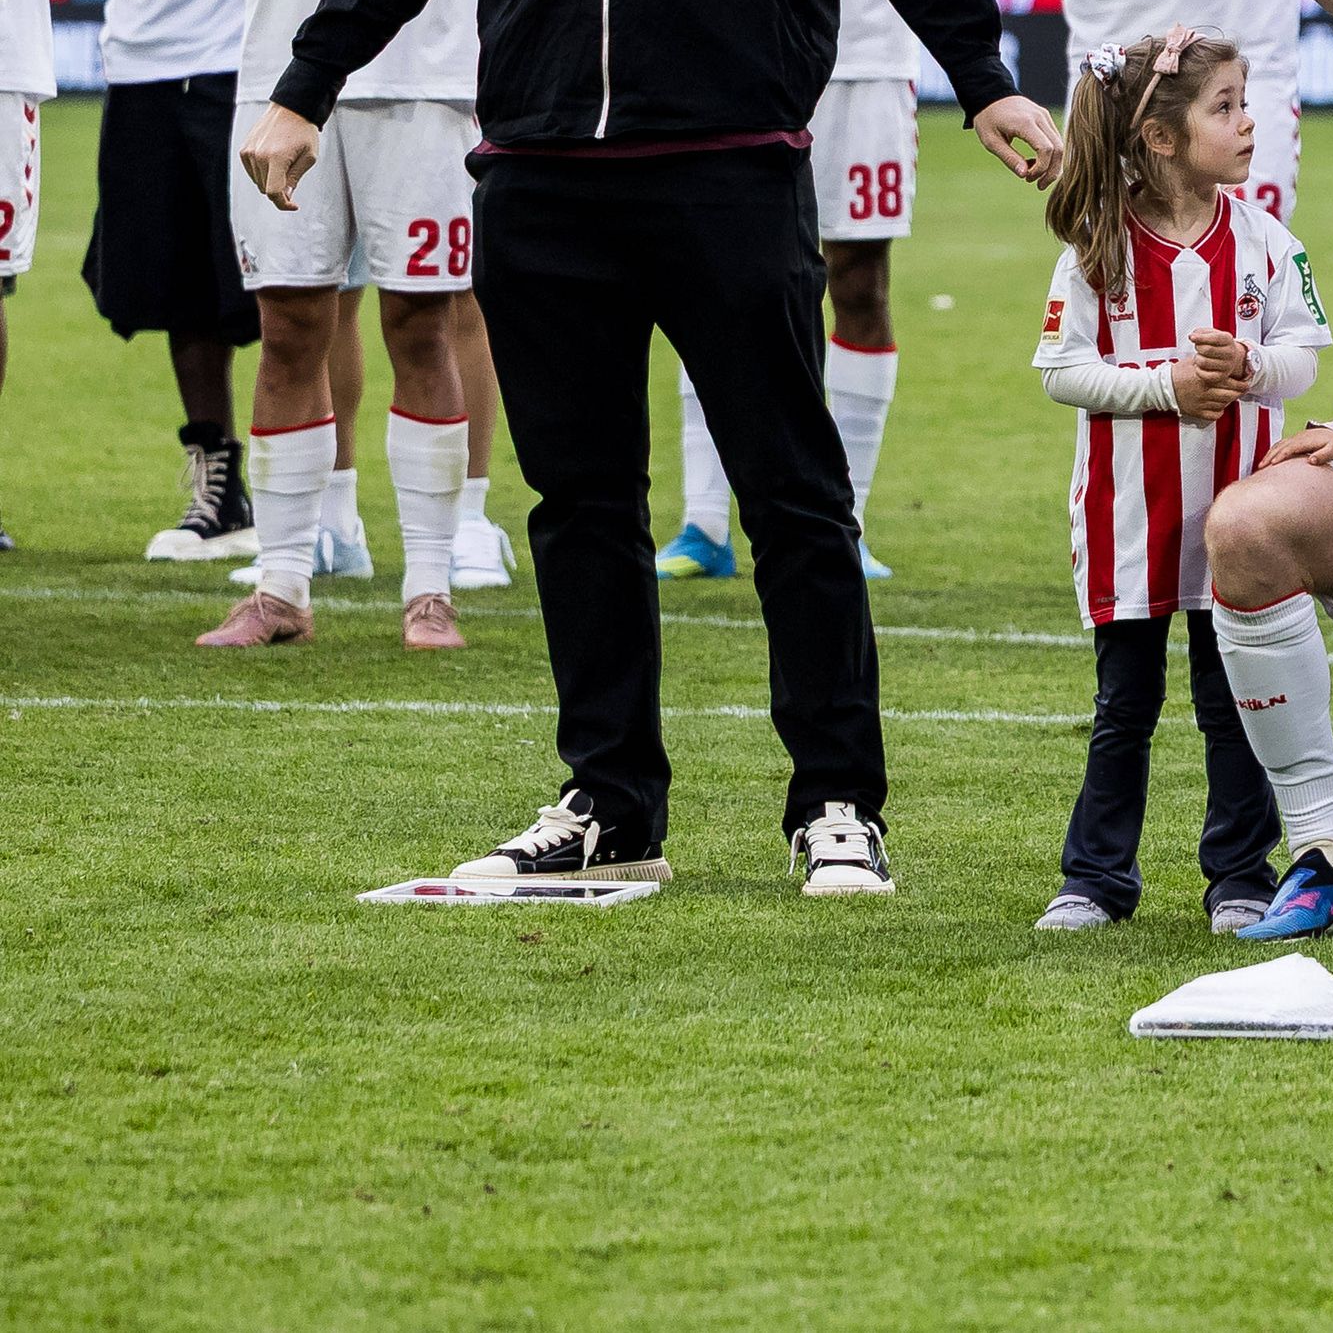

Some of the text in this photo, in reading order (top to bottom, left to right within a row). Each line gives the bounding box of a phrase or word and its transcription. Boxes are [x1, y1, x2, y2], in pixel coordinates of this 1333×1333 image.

[848, 160, 903, 220] 38
[1233, 182, 1283, 220] 3
[406, 216, 472, 277] 28
[1300, 260, 1325, 324] DEVK
